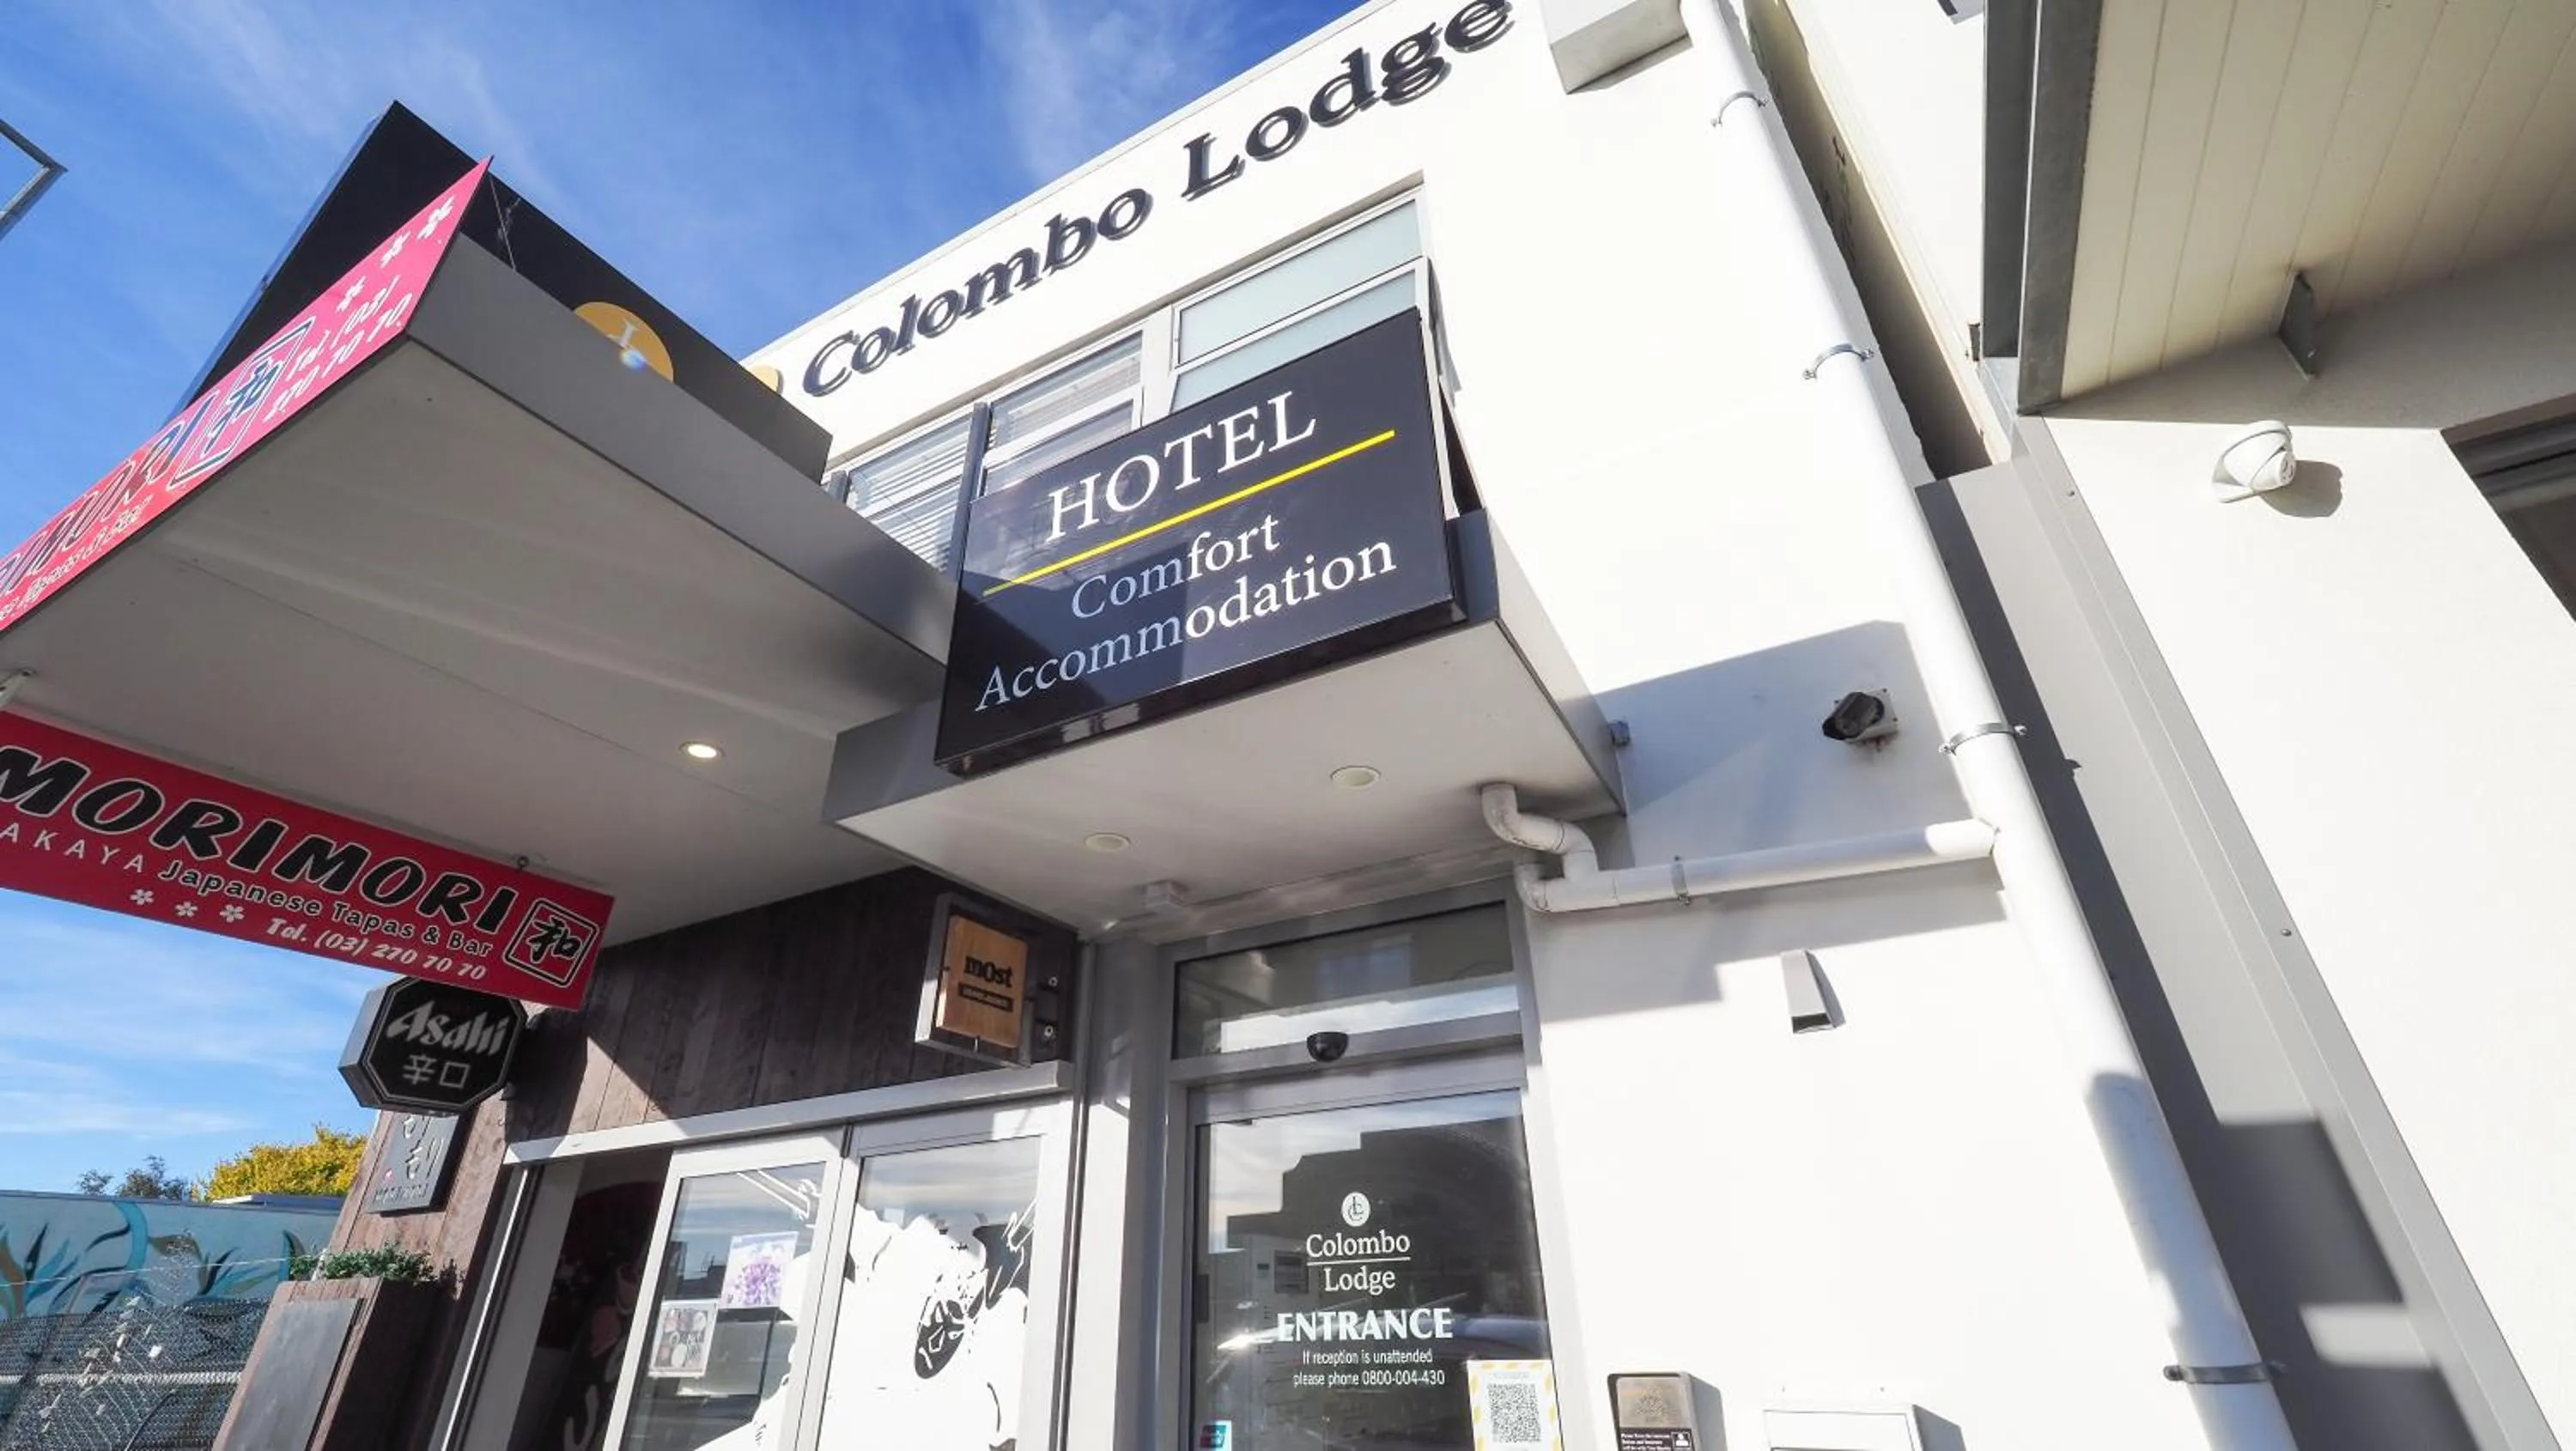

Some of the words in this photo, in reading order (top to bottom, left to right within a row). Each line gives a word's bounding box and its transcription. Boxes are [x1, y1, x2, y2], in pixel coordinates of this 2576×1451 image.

[803, 185, 1151, 396] Colombo
[1182, 0, 1513, 201] Lodge
[1044, 391, 1316, 543] HOTEL
[1071, 515, 1280, 618] Comfort
[975, 540, 1396, 713] Accommodation
[0, 744, 519, 936] MORIMORI
[158, 860, 324, 917] Japanese
[332, 901, 417, 940] Tapas
[422, 924, 441, 946] &
[446, 930, 494, 959] Bar
[265, 915, 307, 943] Tel.
[314, 928, 368, 956] (03)
[371, 942, 417, 966] 270
[422, 954, 453, 974] 70
[457, 962, 488, 980] 70
[526, 915, 584, 964] 和
[386, 999, 510, 1056] Asahi
[403, 1053, 471, 1089] 辛口
[1305, 1229, 1410, 1258] Colombo
[1323, 1266, 1396, 1296] Lodge
[1277, 1308, 1453, 1342] ENTRANCE
[1293, 1371, 1325, 1387] please
[1327, 1371, 1359, 1388] phone
[1362, 1369, 1445, 1386] 0800-004-430
[1313, 1349, 1358, 1367] reception
[1361, 1349, 1370, 1364] is
[1373, 1348, 1433, 1364] unattended
